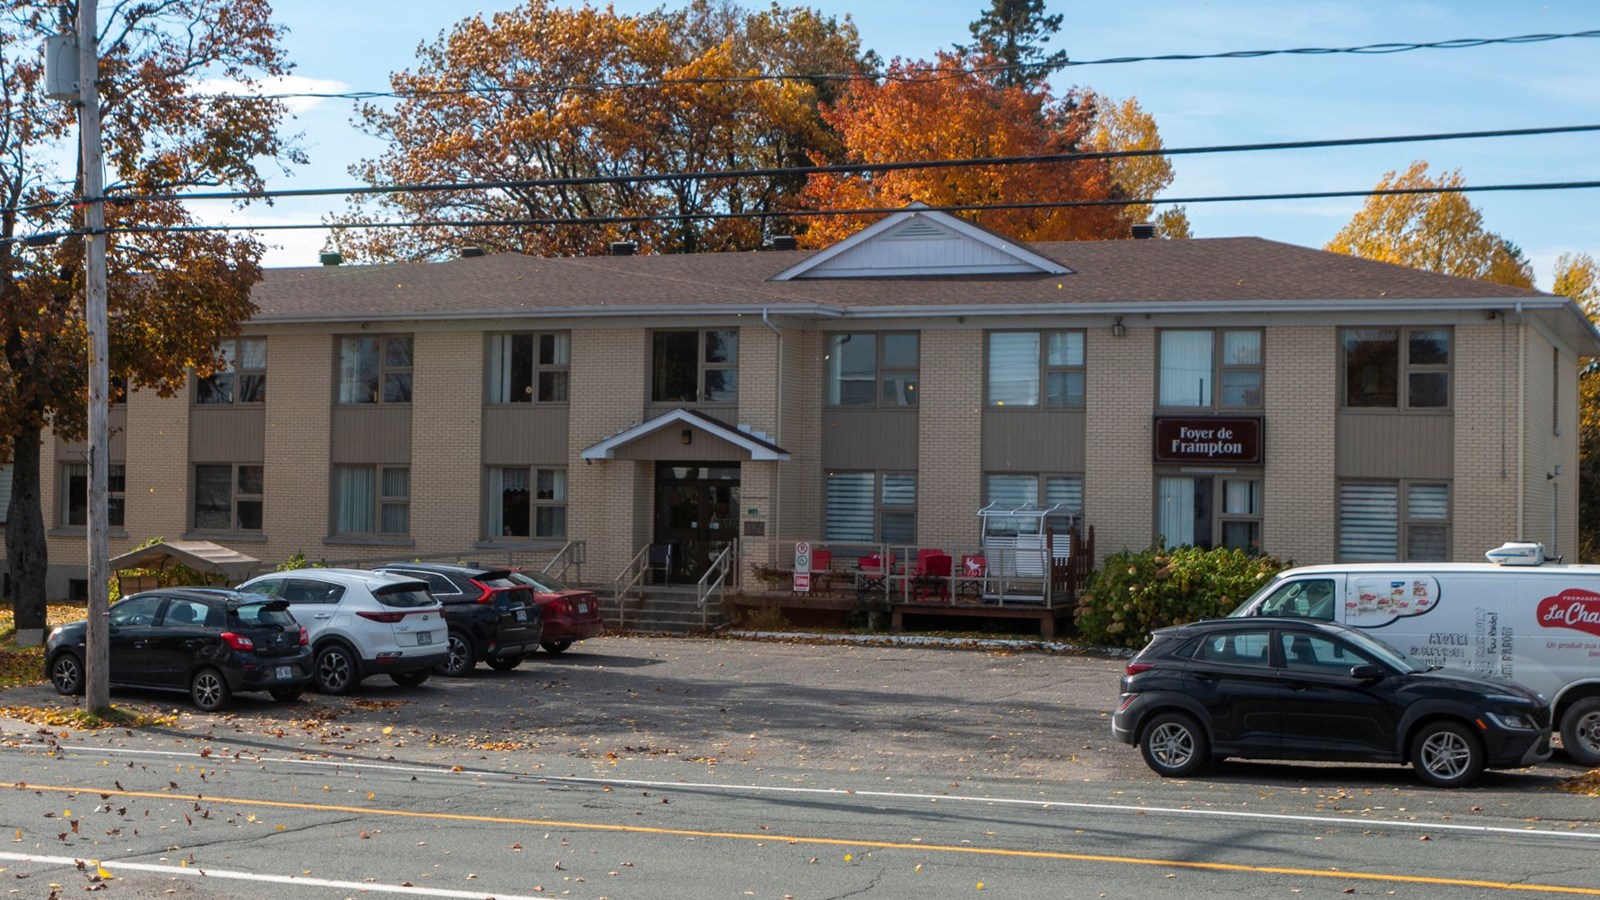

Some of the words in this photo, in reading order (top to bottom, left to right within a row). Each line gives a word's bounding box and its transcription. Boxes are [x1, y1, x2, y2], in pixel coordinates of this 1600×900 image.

[1180, 427, 1214, 441] Foyer
[1217, 427, 1233, 439] de
[1171, 440, 1242, 457] Frampton
[1543, 604, 1565, 620] La
[1565, 602, 1600, 625] Cha
[1546, 641, 1557, 649] Un
[1558, 641, 1583, 649] produit
